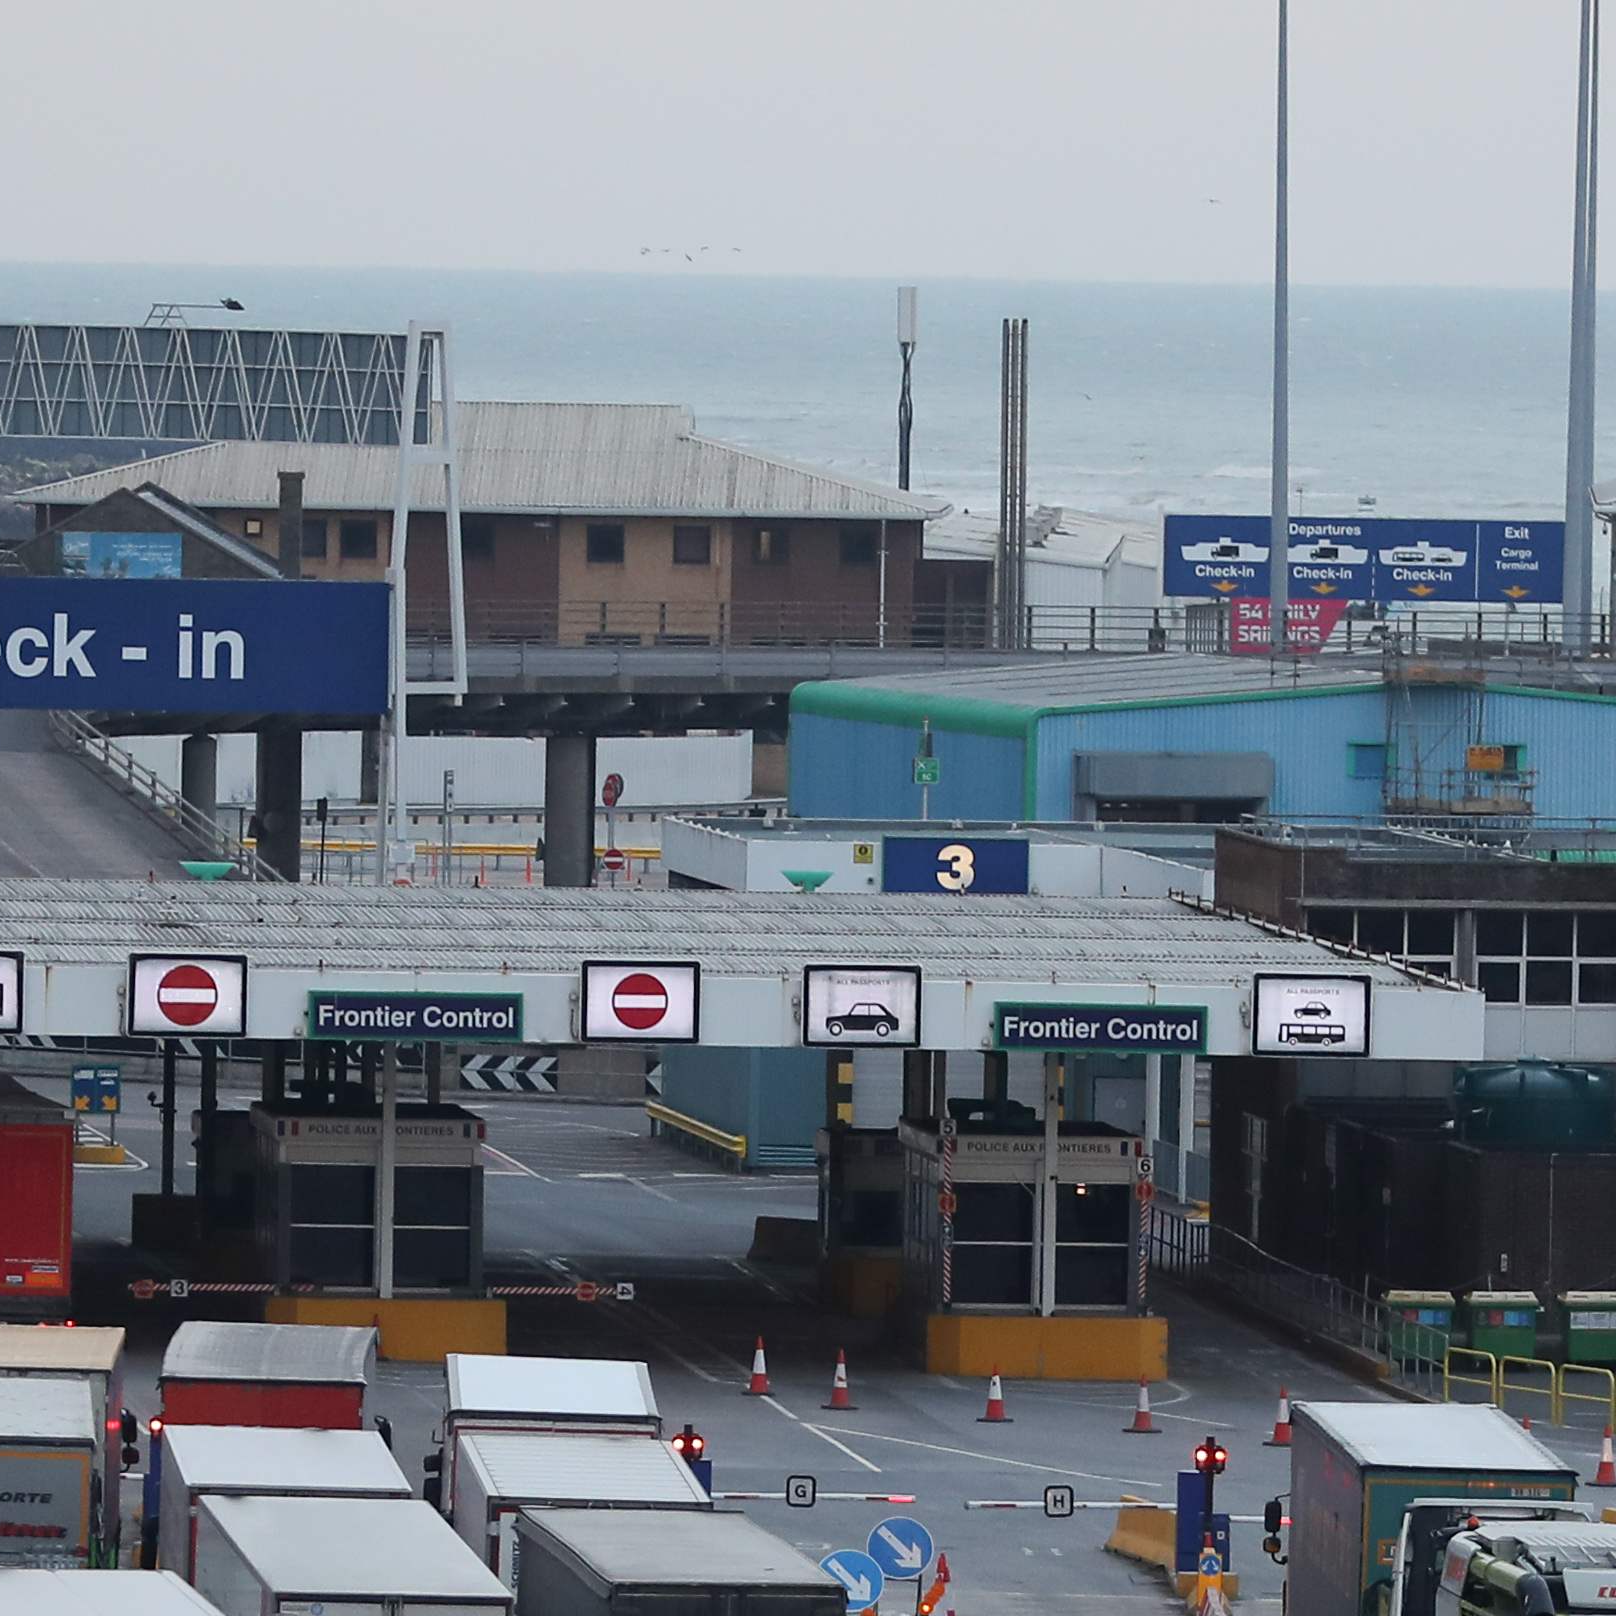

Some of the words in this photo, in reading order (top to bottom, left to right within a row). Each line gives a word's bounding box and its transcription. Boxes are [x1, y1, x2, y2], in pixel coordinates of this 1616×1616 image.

[1288, 523, 1362, 537] Departures
[1504, 526, 1529, 540] Exit
[1500, 547, 1532, 559] Cargo
[1494, 560, 1539, 571] Terminal
[1239, 603, 1263, 619] 54
[122, 646, 147, 660] -
[179, 614, 245, 679] in
[936, 844, 975, 891] 3
[318, 1005, 416, 1027] Frontier
[423, 1006, 514, 1029] Control
[1003, 1016, 1100, 1039] Frontier
[1107, 1017, 1198, 1041] Control
[308, 1123, 350, 1135] POLICE
[354, 1124, 378, 1136] AUX
[395, 1125, 454, 1137] ONTIERES
[967, 1142, 1009, 1153] POLICE
[1013, 1143, 1035, 1153] AUX
[1140, 1158, 1151, 1173] 6
[174, 1281, 184, 1295] 3
[795, 1483, 807, 1498] G
[1053, 1494, 1065, 1508] H
